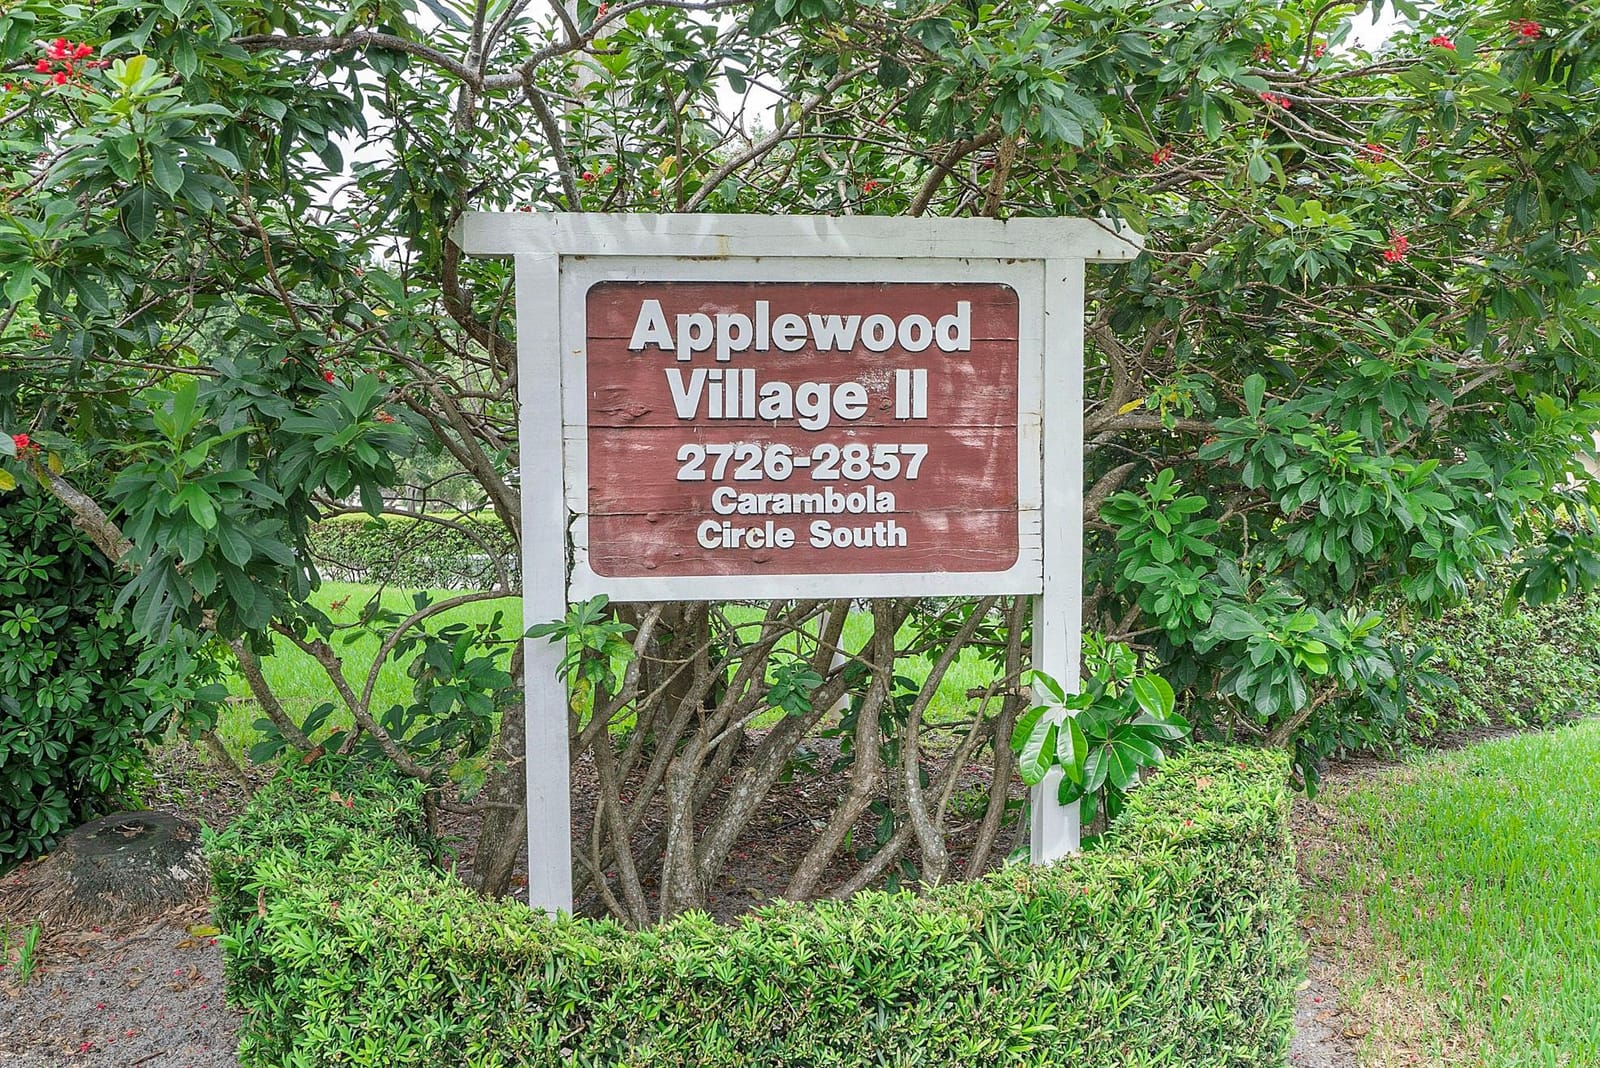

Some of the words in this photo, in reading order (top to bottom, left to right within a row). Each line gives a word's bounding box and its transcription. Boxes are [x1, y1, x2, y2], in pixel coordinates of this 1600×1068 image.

[629, 299, 971, 361] Applewood
[665, 368, 868, 431] Village
[894, 368, 928, 419] II
[676, 443, 929, 480] 2726-2857
[711, 485, 896, 515] Carambola
[696, 519, 795, 549] Circle
[809, 519, 907, 549] South
